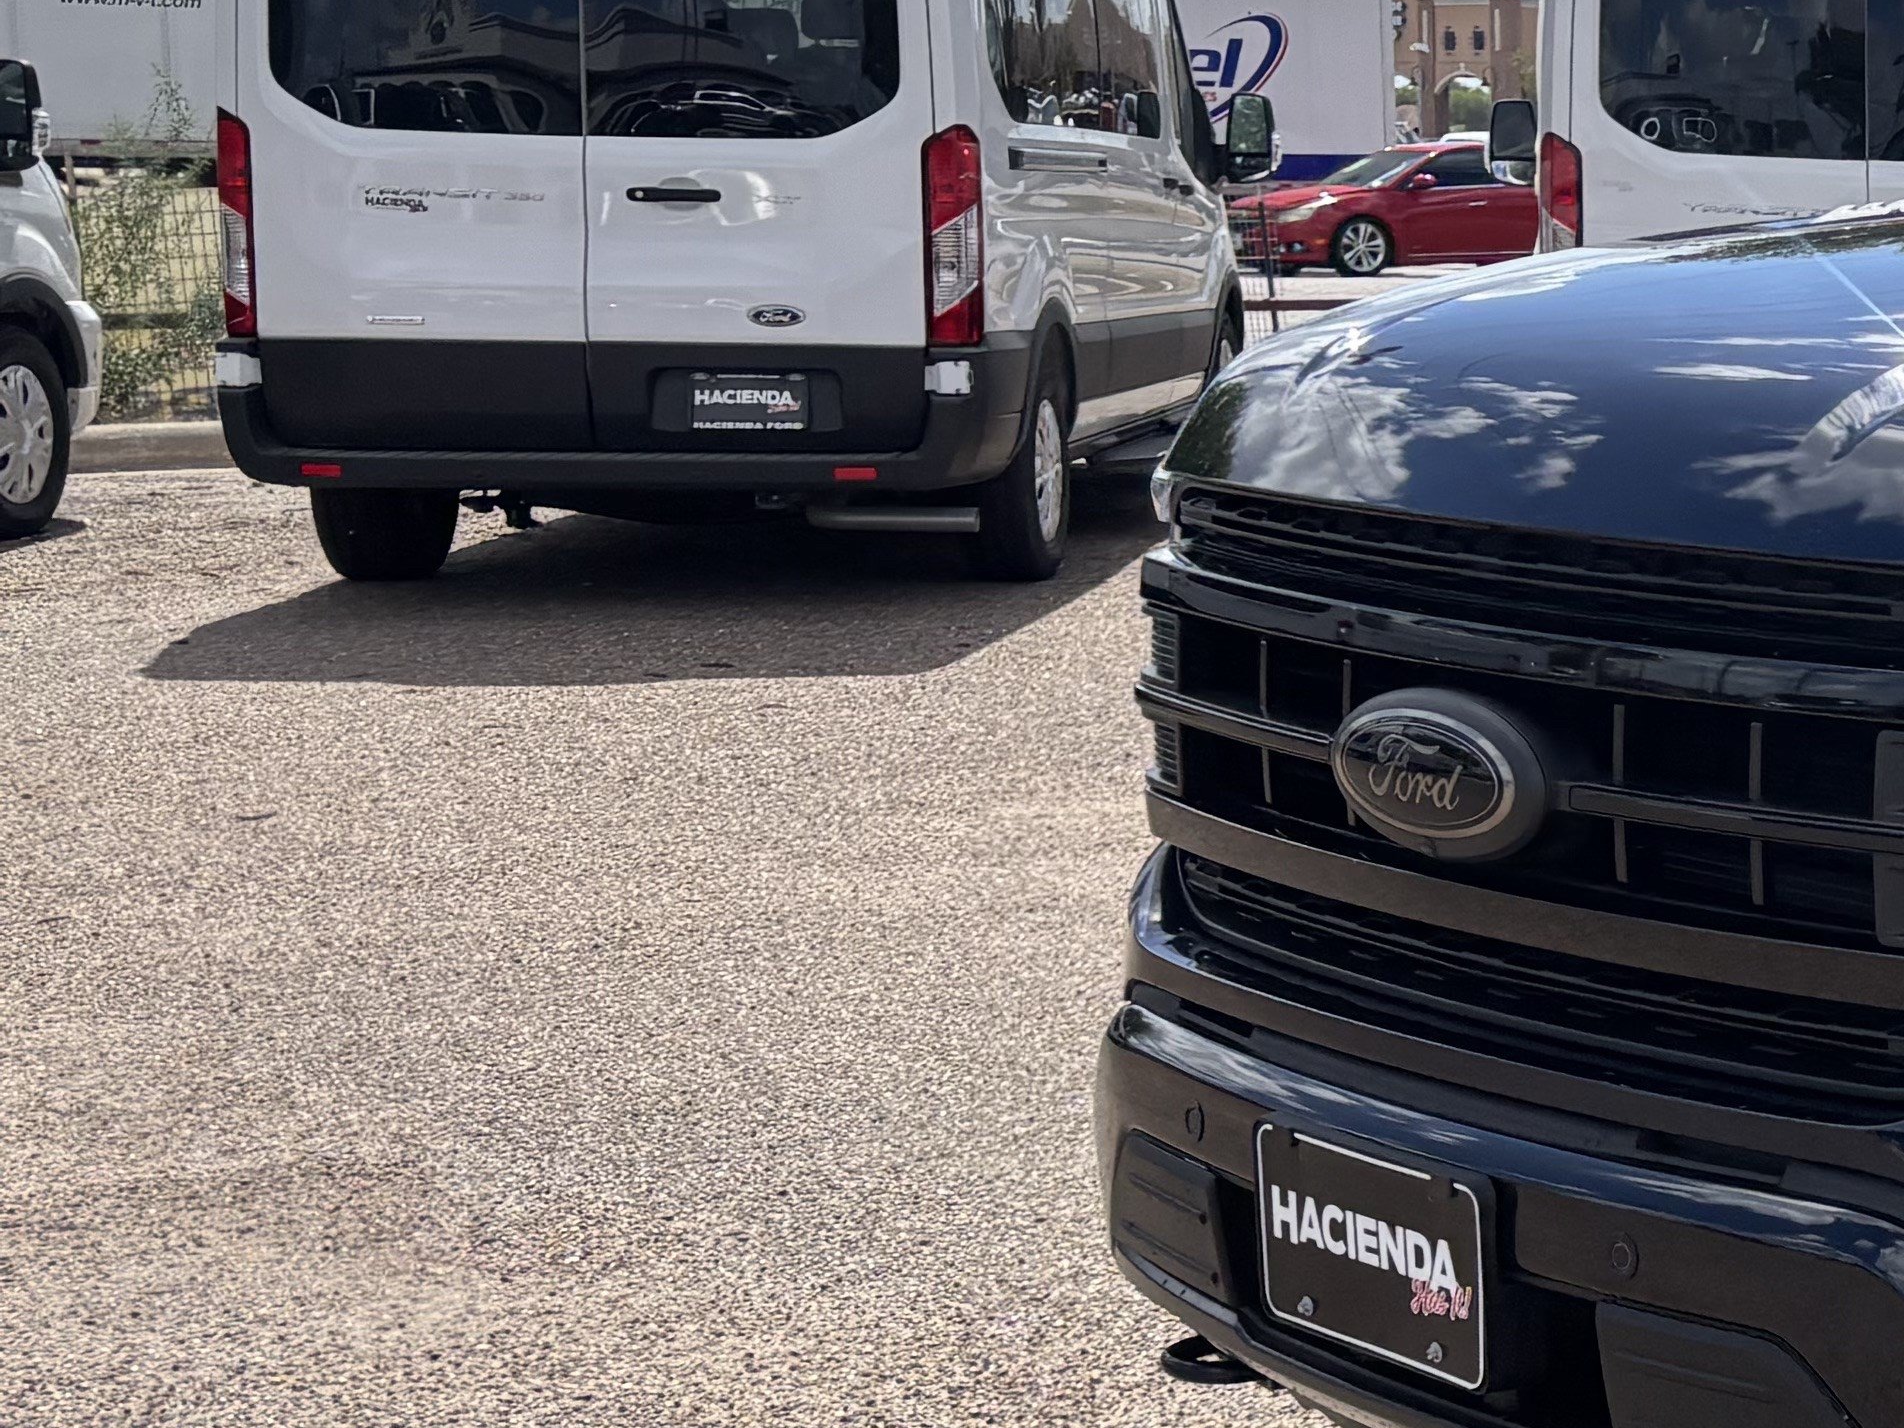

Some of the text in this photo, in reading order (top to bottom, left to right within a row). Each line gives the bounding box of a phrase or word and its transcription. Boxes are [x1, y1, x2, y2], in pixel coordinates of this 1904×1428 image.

[693, 389, 794, 406] HACIENDA
[1367, 732, 1464, 811] Ford
[1271, 1183, 1457, 1298] HACIENDA
[1410, 1278, 1450, 1317] Has
